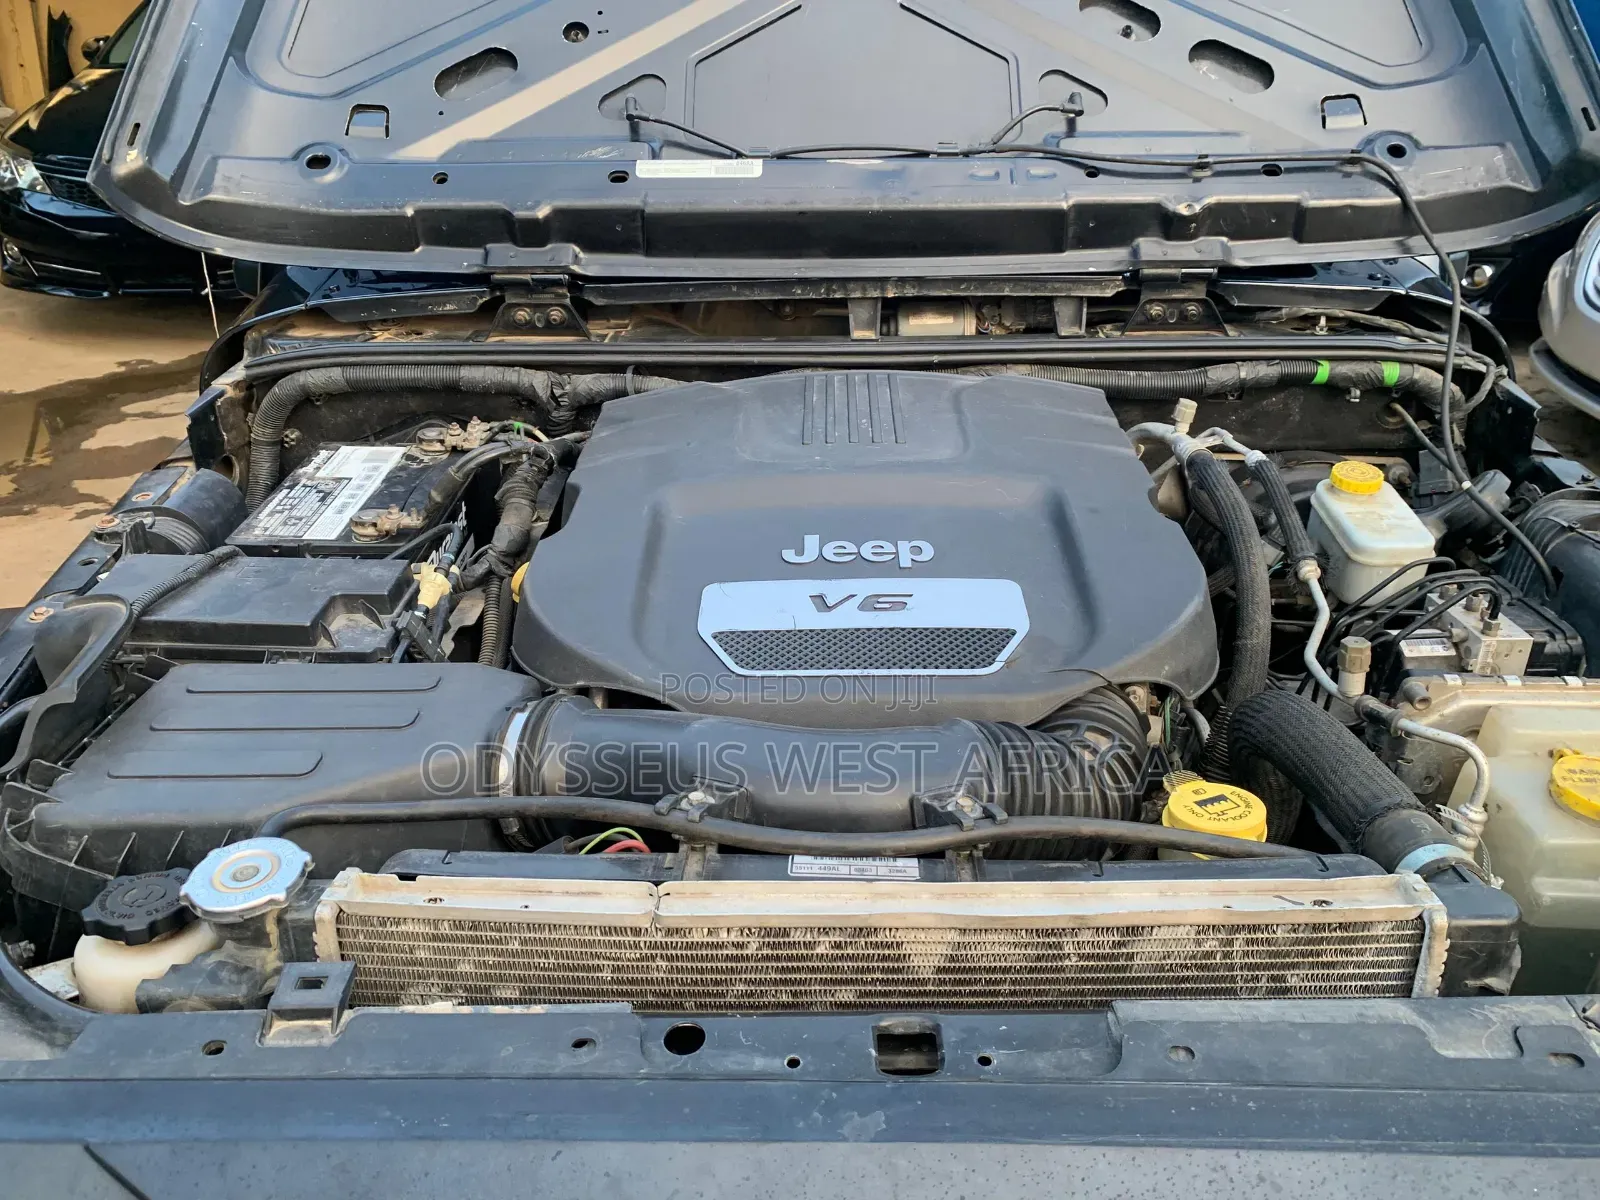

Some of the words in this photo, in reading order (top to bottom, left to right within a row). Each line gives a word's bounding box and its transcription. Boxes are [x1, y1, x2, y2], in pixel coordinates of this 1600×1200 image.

[781, 534, 935, 569] Jeep
[809, 593, 914, 613] V6
[1230, 791, 1253, 810] ENGINE
[1183, 804, 1204, 818] ONLY
[1207, 810, 1251, 822] COOLANT
